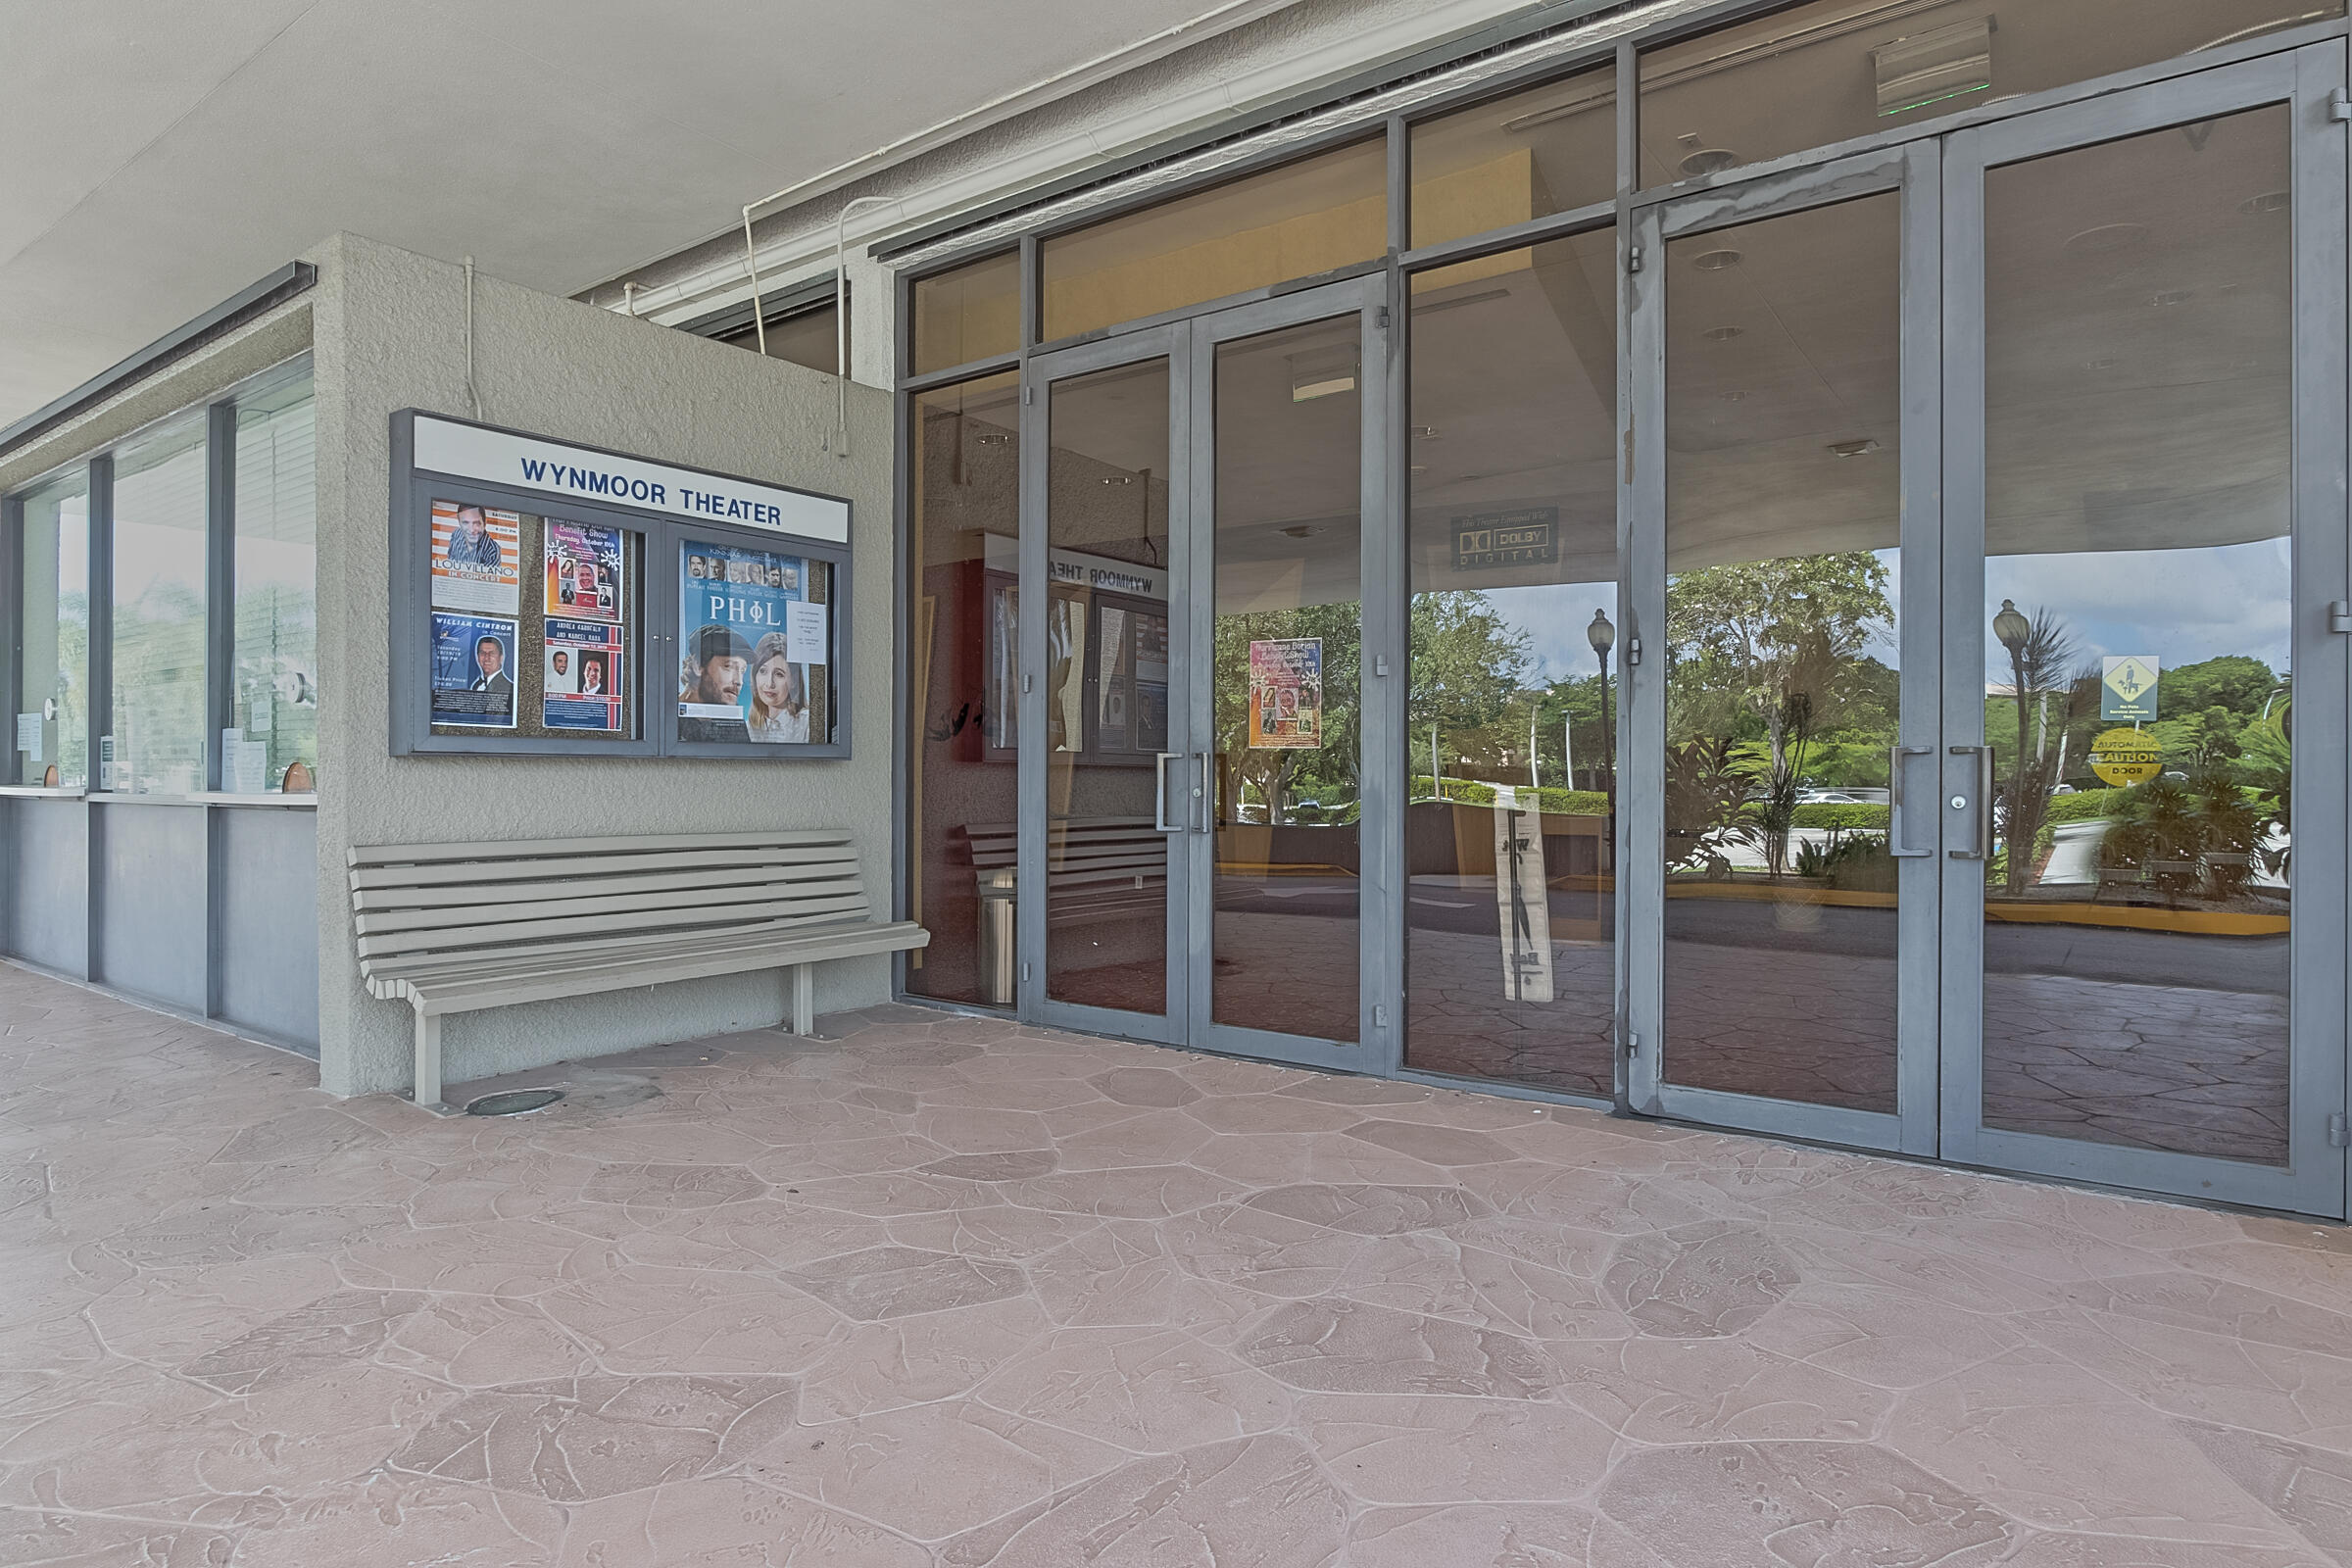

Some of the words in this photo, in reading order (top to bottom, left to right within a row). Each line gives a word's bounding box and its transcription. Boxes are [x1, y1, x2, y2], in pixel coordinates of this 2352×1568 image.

[520, 457, 665, 505] WYNMOOR
[679, 488, 781, 526] THEATER
[559, 524, 587, 536] Benefit
[589, 529, 609, 539] Show
[1499, 531, 1542, 545] DOLBY
[1460, 548, 1548, 565] DIGITAL
[435, 558, 462, 571] LOU
[466, 563, 514, 577] VILLANO
[461, 572, 502, 582] CONCERT
[436, 617, 472, 627] WILLIAM
[475, 621, 513, 631] CINTRON
